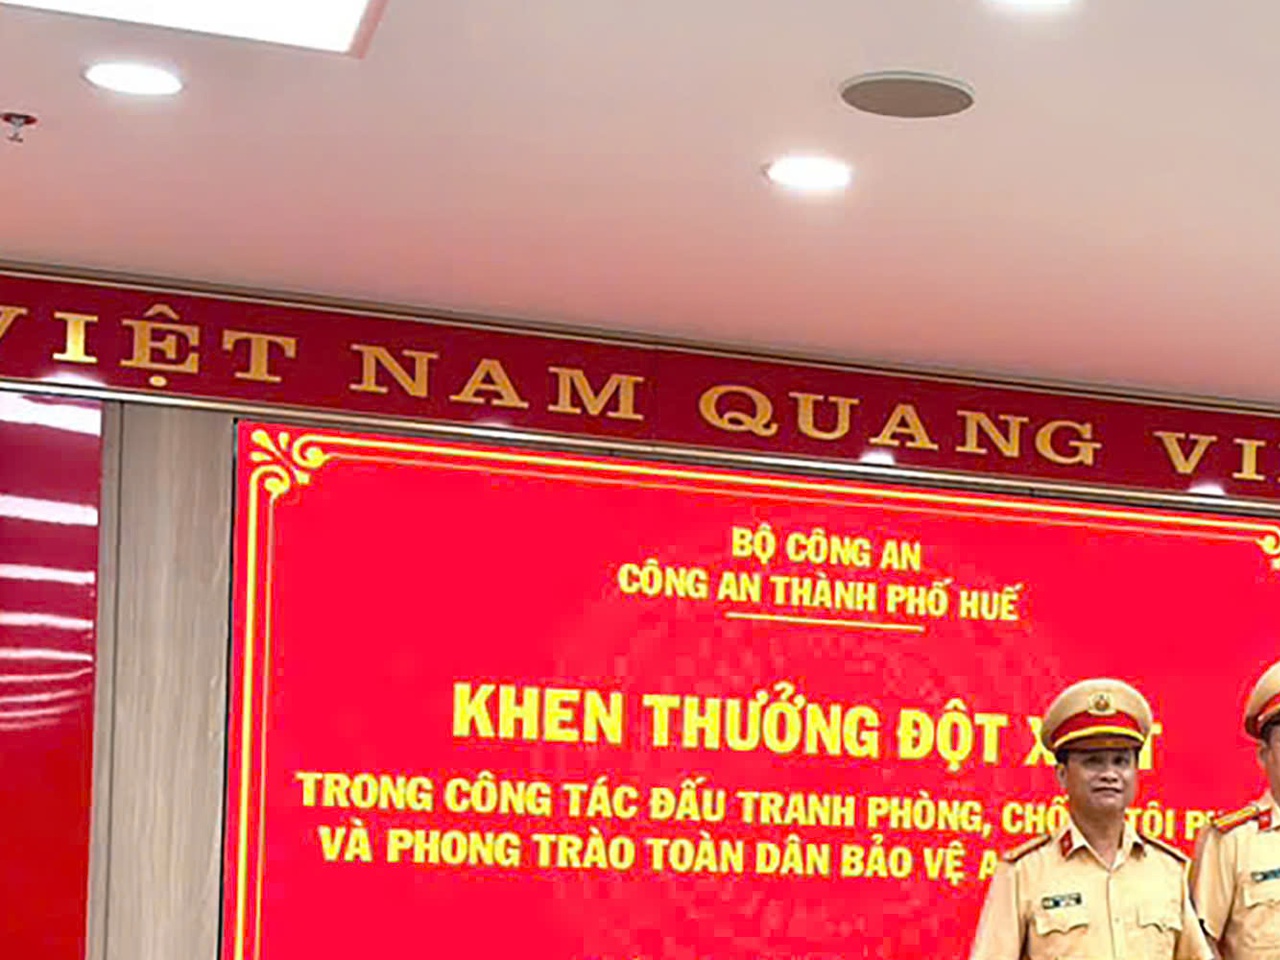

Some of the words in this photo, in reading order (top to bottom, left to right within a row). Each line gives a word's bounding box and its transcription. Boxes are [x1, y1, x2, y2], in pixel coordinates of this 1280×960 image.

[348, 344, 645, 421] NAM
[697, 383, 1104, 469] QUANG
[731, 522, 777, 566] BỘ
[785, 526, 872, 568] CÔNG
[879, 541, 922, 573] AN
[617, 557, 708, 600] CÔNG
[716, 571, 762, 603] AN
[769, 571, 878, 613] THÀNH
[885, 577, 954, 619] PHỐ
[958, 582, 1024, 622] HUẾ
[452, 681, 625, 745] KHEN
[642, 680, 880, 759] THƯỞNG
[895, 697, 1009, 772] ĐỘT
[295, 771, 434, 813] TRONG
[443, 769, 552, 818] CÔNG
[561, 775, 640, 820] TÁC
[648, 775, 726, 823] ĐẤU
[736, 789, 857, 828] TRANH
[866, 789, 993, 837] PHÒNG,
[318, 817, 374, 863] VÀ
[385, 827, 522, 868] PHONG
[531, 826, 637, 871] TRÀO
[646, 829, 745, 875] TOÀN
[755, 833, 831, 877] DÂN
[840, 832, 913, 880] BẢO
[923, 838, 967, 886] VỆ
